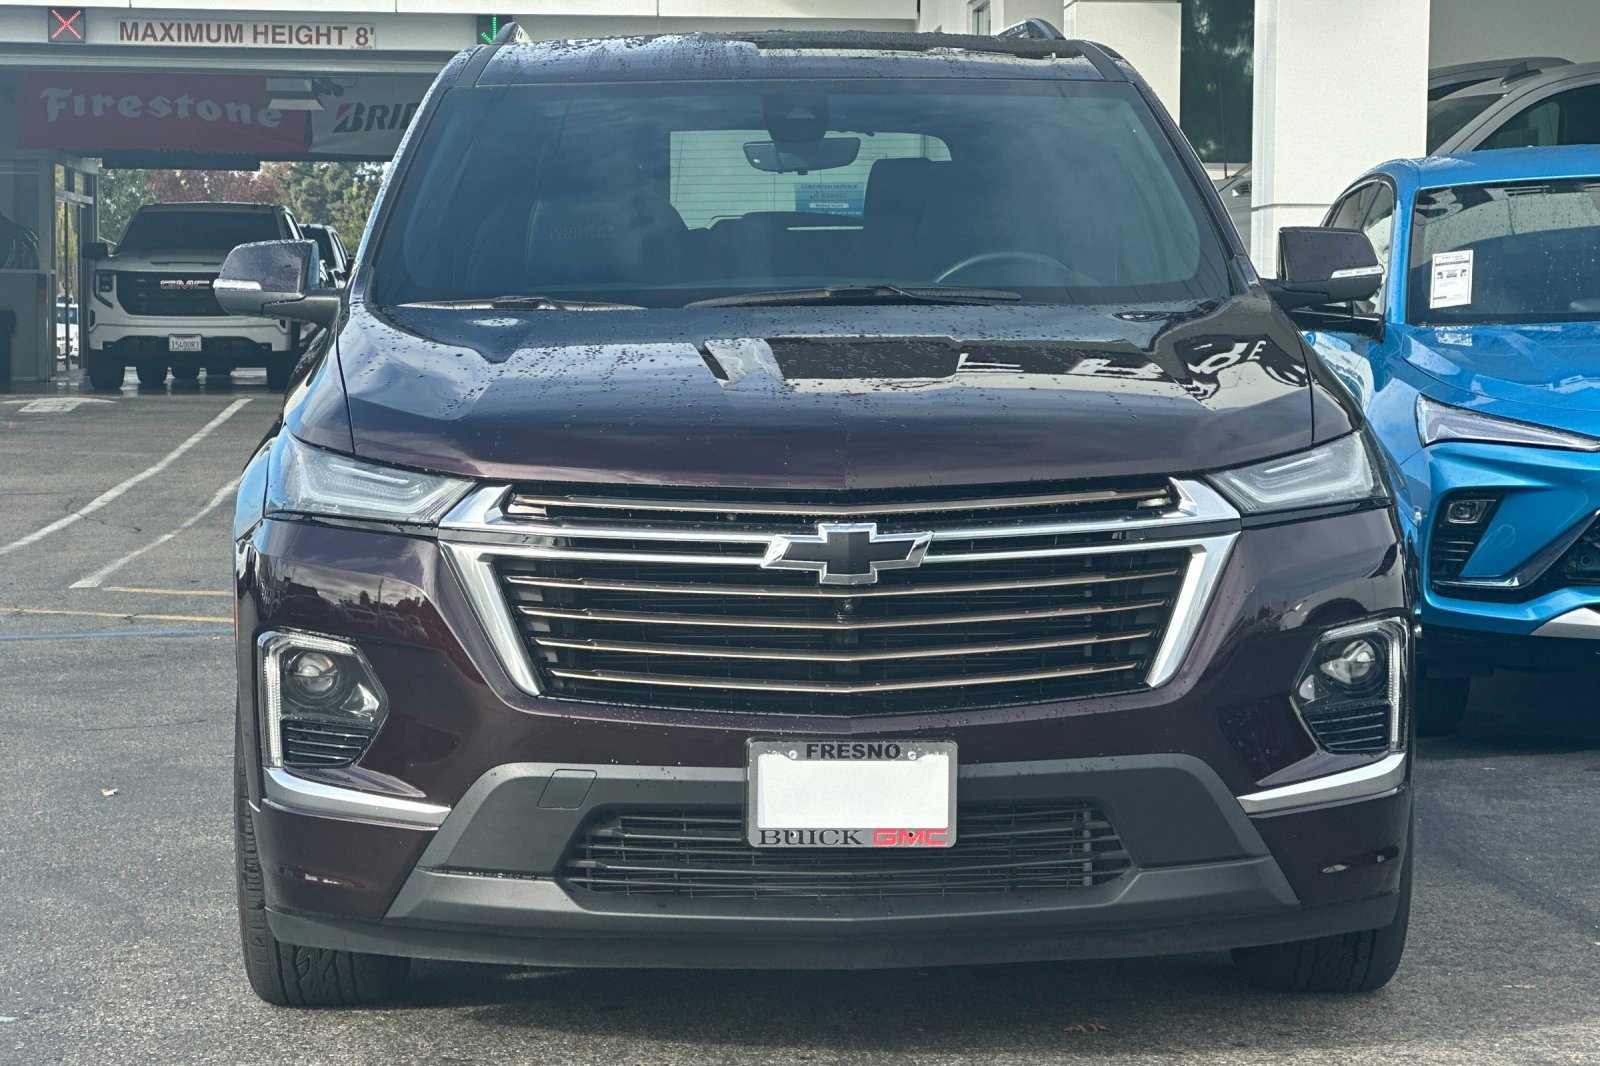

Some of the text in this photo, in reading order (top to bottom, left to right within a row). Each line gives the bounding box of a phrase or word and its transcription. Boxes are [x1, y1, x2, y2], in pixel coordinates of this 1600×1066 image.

[119, 22, 375, 46] MAXIMUM HEIGHT 8'
[40, 88, 282, 127] Firestone
[160, 280, 210, 289] GMC
[806, 743, 900, 759] FRESNO
[757, 828, 947, 846] BUICK GMC
